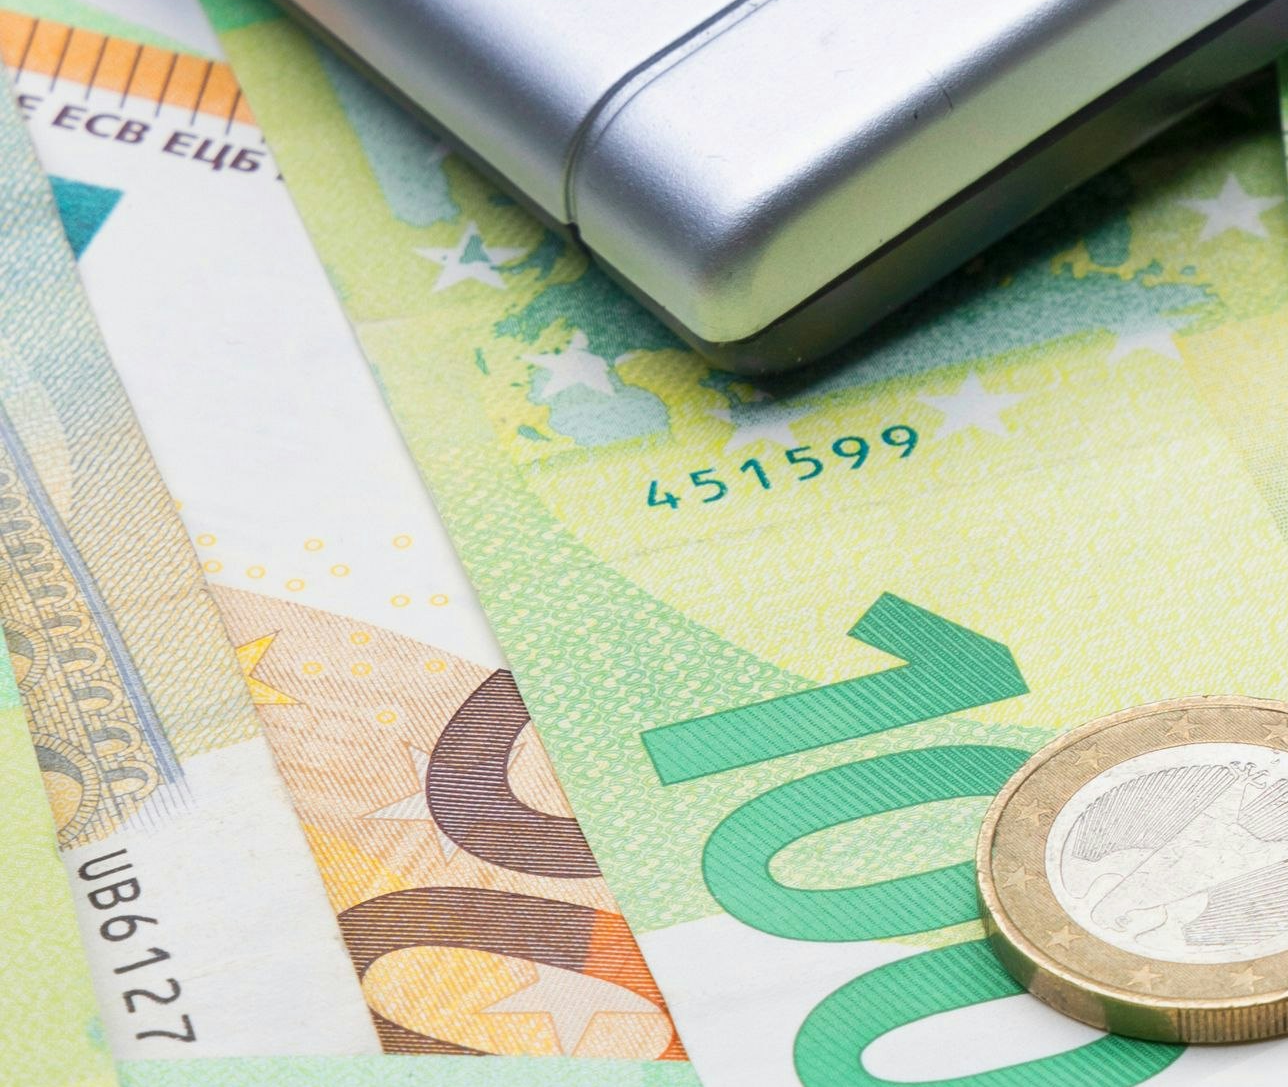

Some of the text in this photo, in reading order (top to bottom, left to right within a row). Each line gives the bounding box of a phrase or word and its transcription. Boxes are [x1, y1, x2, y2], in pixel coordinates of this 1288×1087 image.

[52, 104, 151, 145] ECB
[646, 424, 920, 511] 451599
[78, 848, 197, 1045] UB6127
